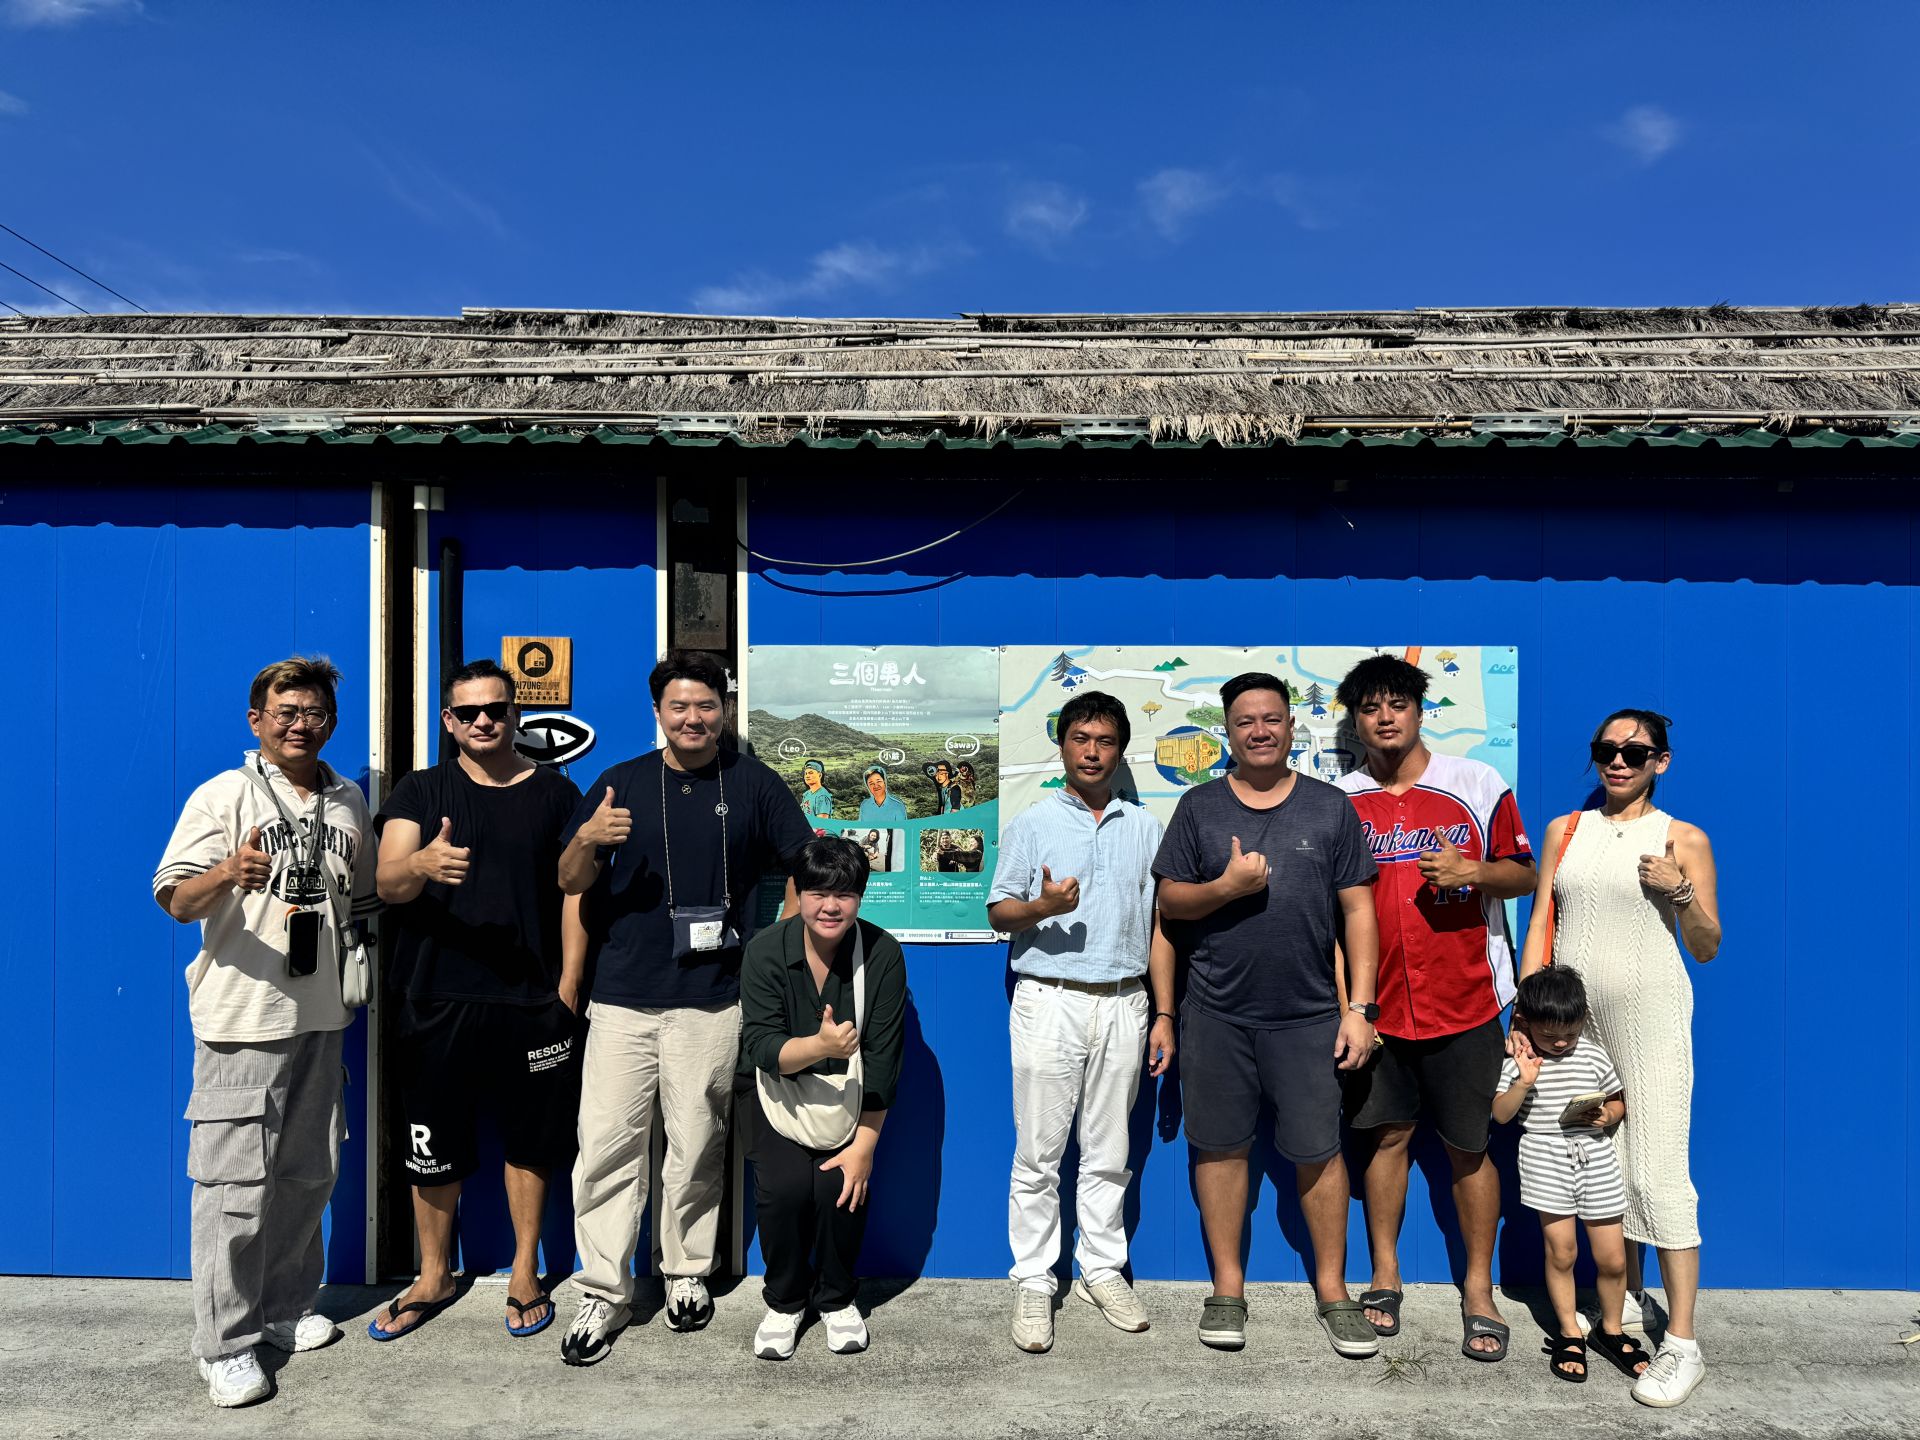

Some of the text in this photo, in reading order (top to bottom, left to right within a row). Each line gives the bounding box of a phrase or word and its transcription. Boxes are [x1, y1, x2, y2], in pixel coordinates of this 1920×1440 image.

[829, 661, 927, 686] 三個男人
[785, 745, 800, 753] Leo
[948, 741, 976, 751] Saway
[410, 1123, 433, 1157] R
[422, 1163, 452, 1175] BADLIFE
